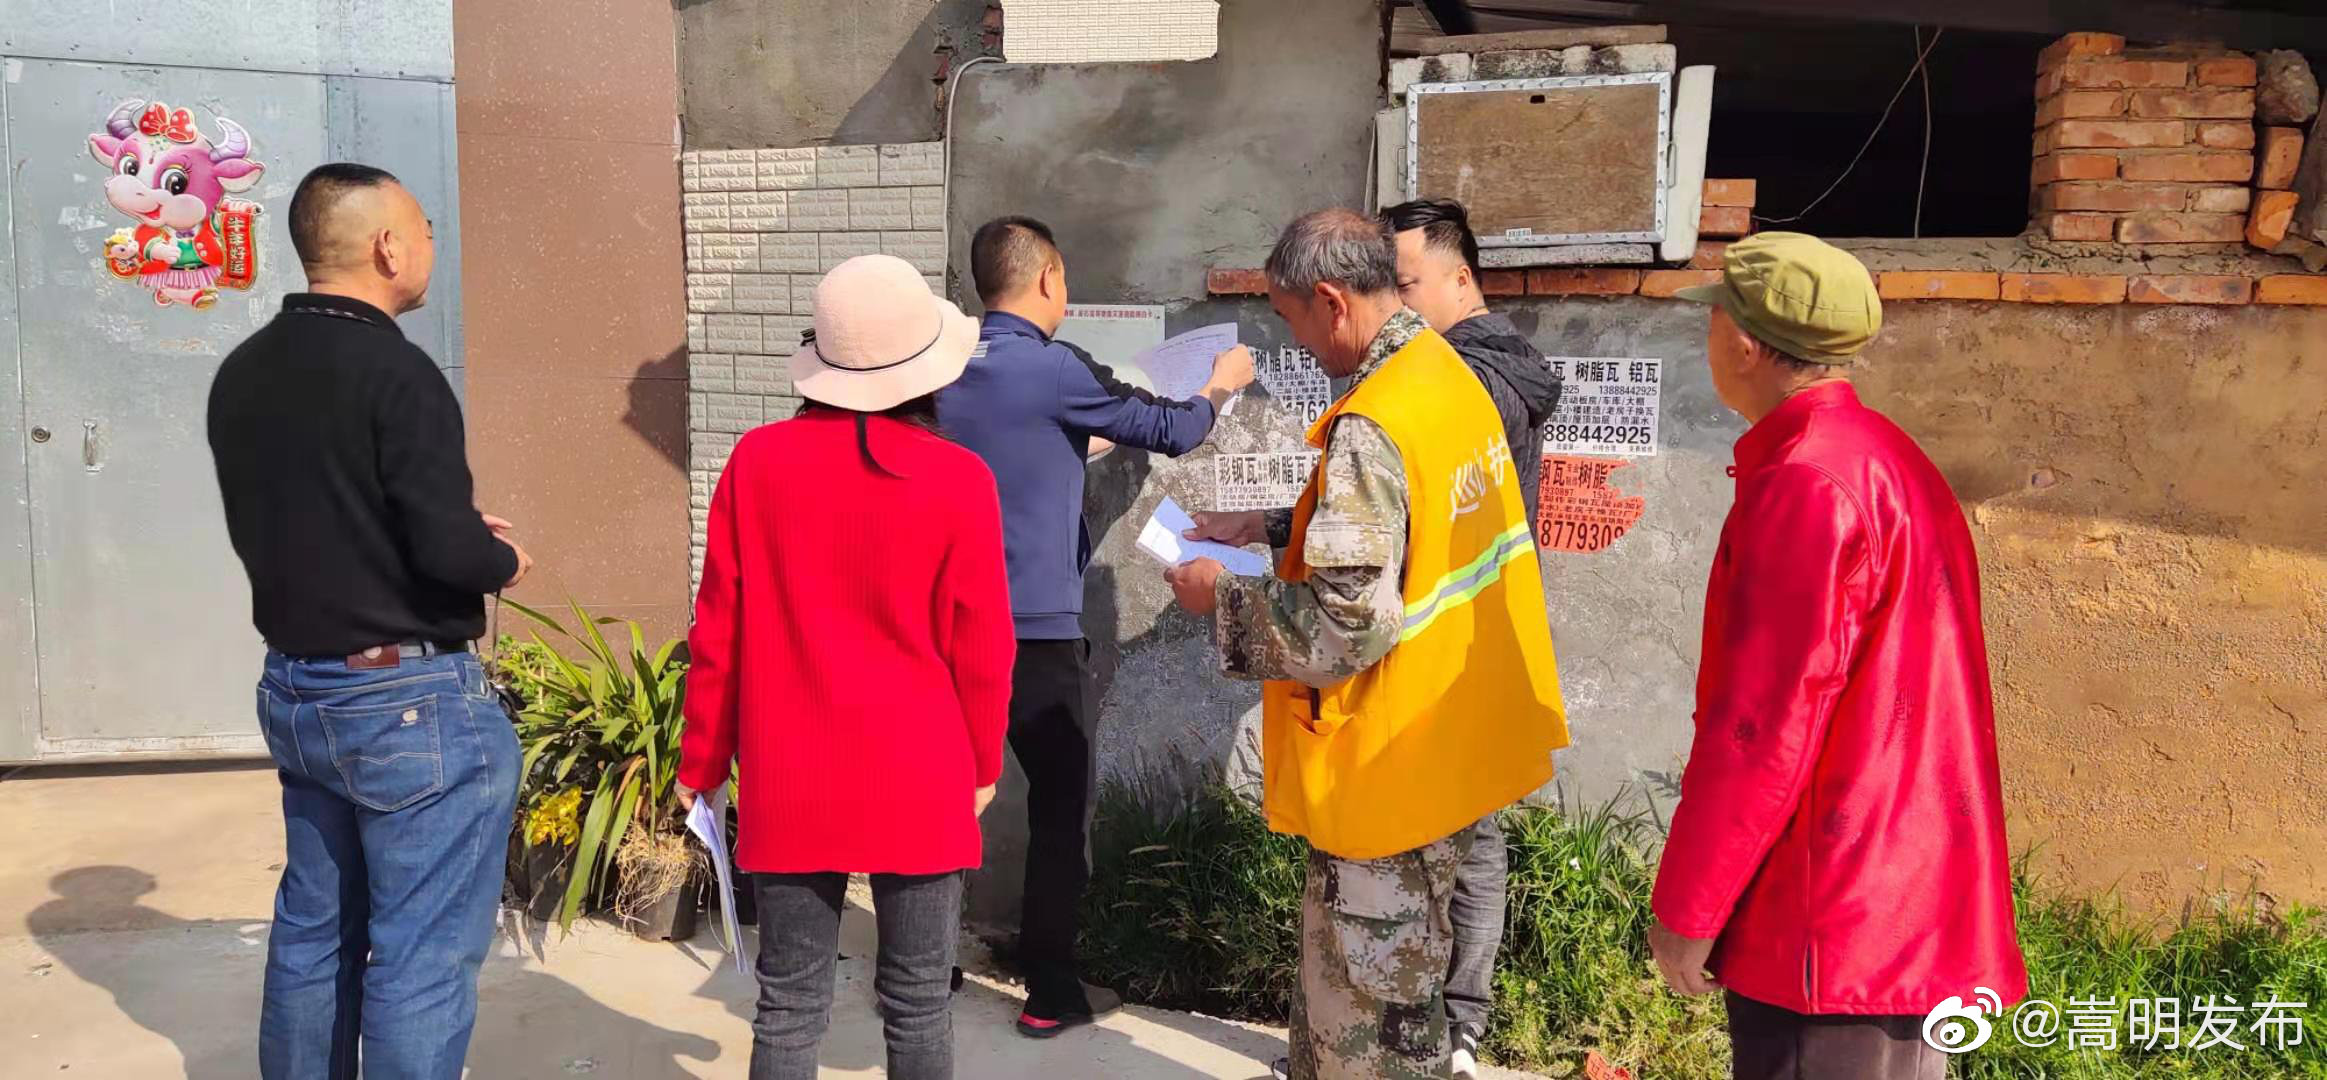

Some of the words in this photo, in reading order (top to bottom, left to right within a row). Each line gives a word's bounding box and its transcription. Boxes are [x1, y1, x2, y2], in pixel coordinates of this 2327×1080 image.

[1575, 360, 1619, 382] 树脂瓦
[1629, 361, 1658, 383] 铝瓦
[1599, 385, 1658, 396] 13888442925
[1542, 424, 1652, 444] 888442925
[1219, 456, 1257, 486] 彩钢瓦
[1268, 455, 1308, 485] 树脂瓦
